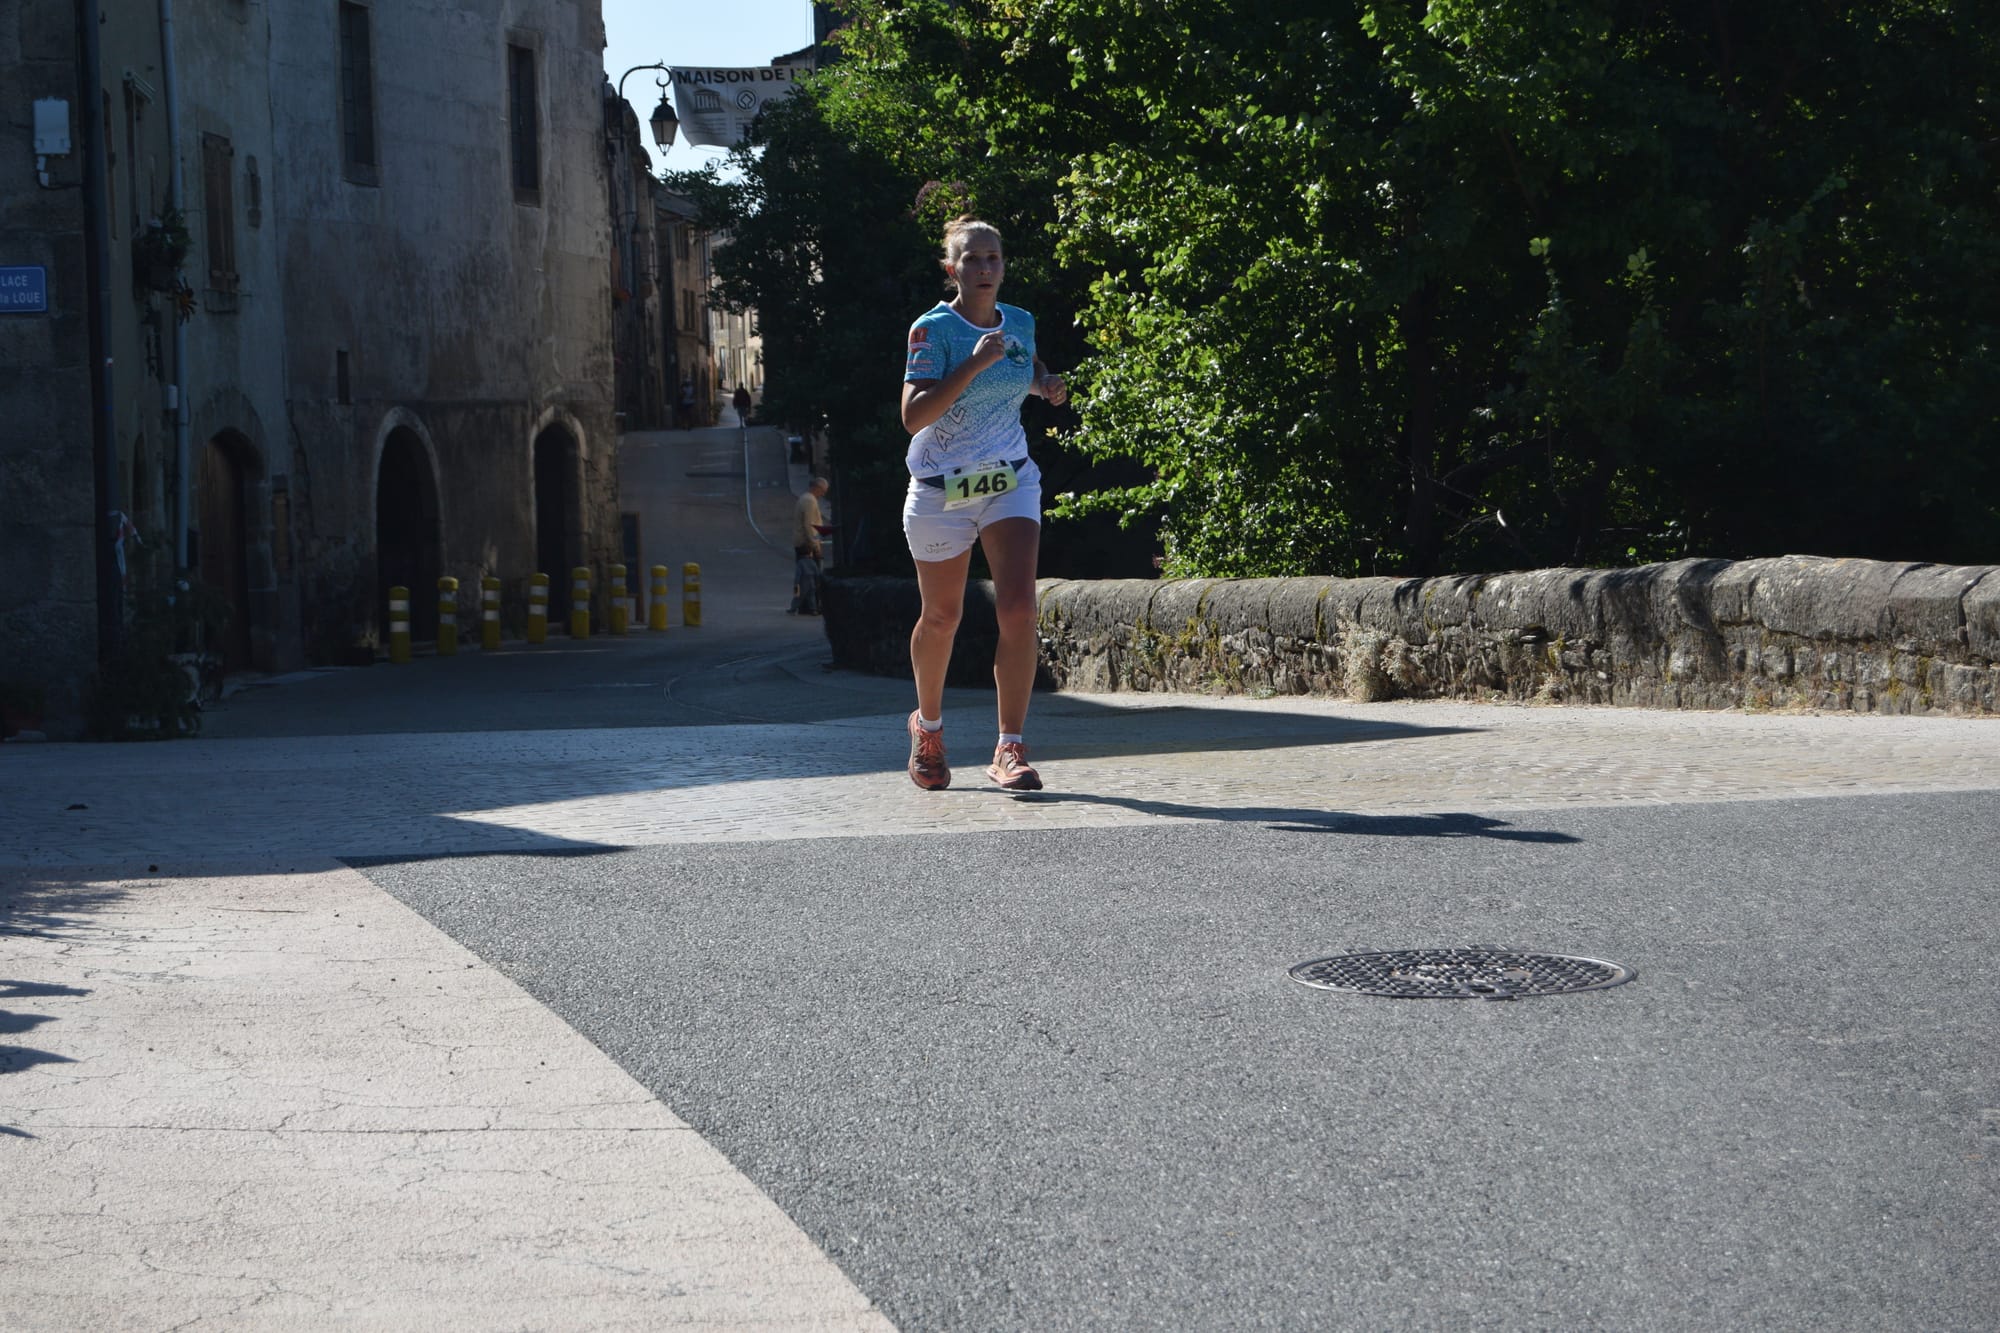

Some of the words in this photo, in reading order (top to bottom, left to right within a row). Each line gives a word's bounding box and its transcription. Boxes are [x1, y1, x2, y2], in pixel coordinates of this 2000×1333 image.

[676, 70, 754, 84] MAISON
[761, 69, 785, 81] DE
[0, 275, 28, 287] LACE
[13, 291, 41, 304] LOUE
[957, 472, 1008, 498] 146
